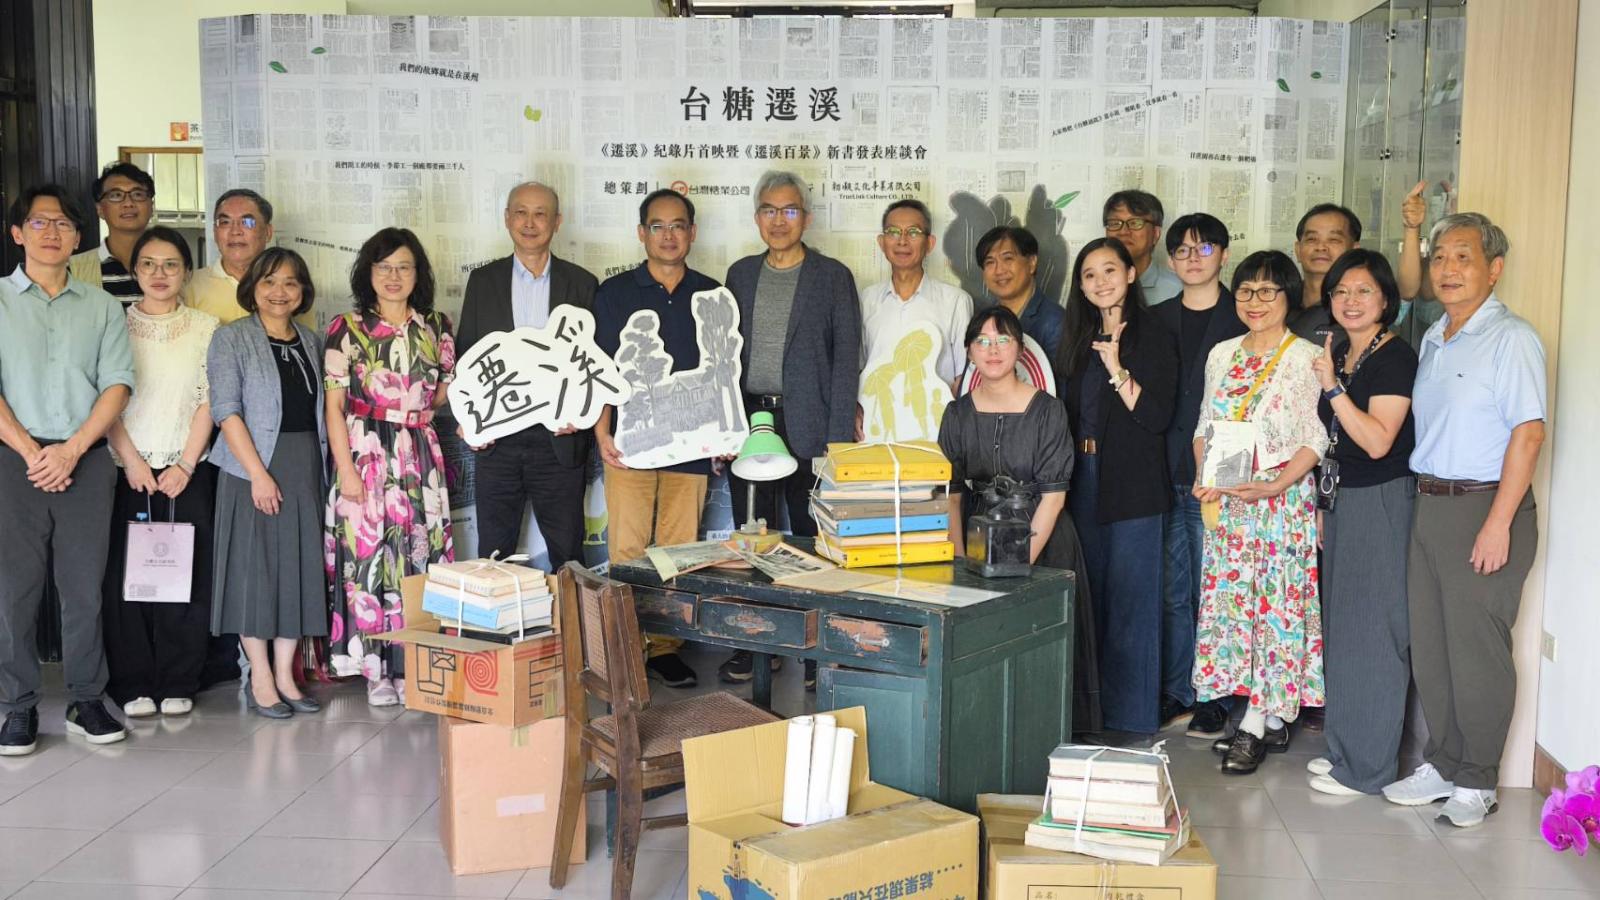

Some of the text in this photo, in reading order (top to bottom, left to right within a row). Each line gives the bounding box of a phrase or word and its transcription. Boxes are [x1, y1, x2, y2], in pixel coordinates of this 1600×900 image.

[680, 86, 842, 122] 台糖遷溪
[601, 143, 927, 161] 《遷溪》紀錄片首映暨《遷溪百景》新書發表座談會
[604, 181, 648, 195] 總策劃
[688, 185, 750, 196] 台灣糖業公司
